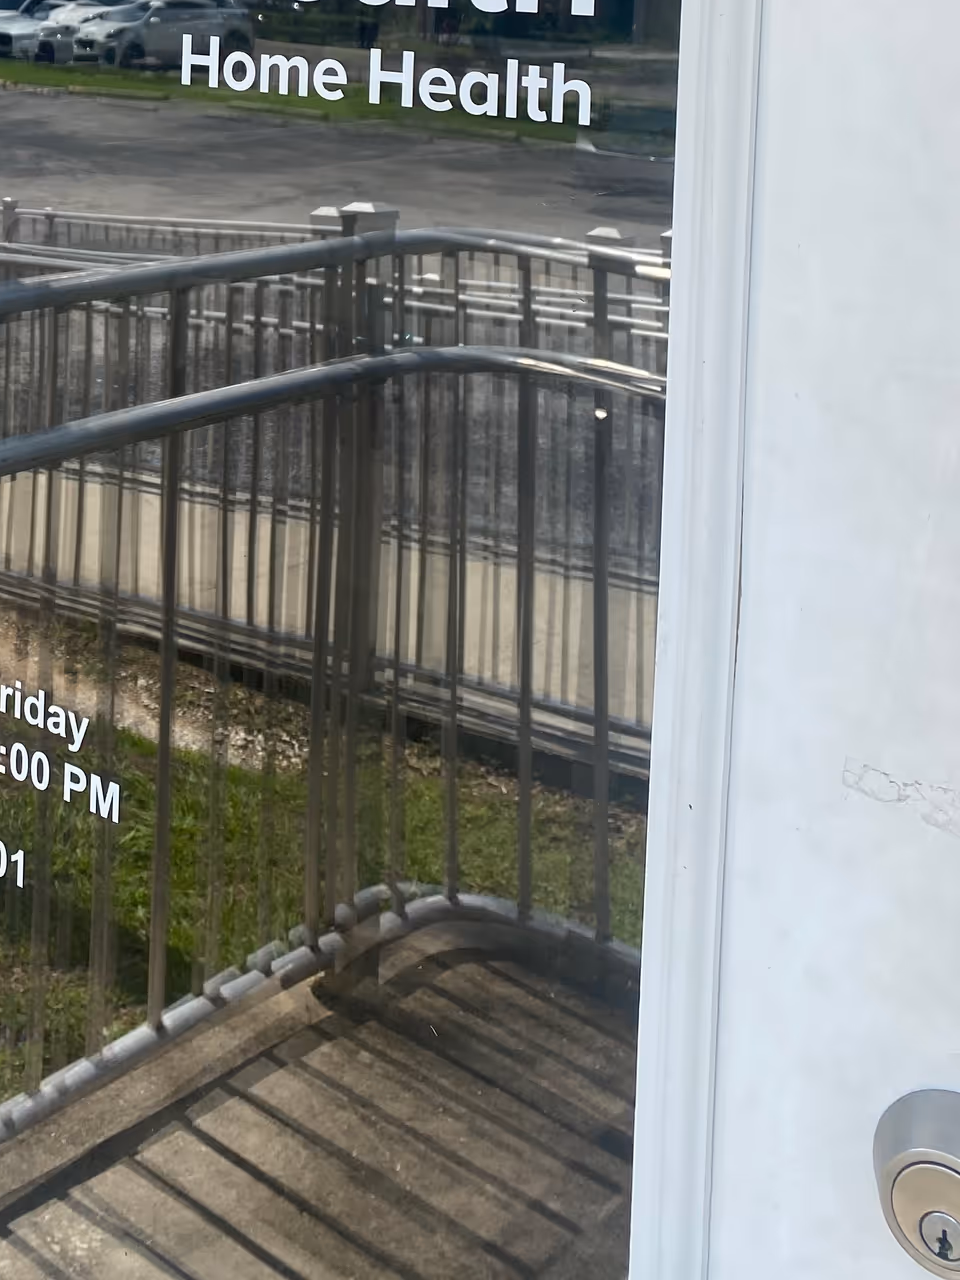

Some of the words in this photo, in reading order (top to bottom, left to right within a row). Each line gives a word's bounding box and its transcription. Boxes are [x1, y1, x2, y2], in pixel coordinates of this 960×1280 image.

[181, 34, 347, 101] Home
[369, 47, 592, 126] Health
[63, 762, 121, 824] PM
